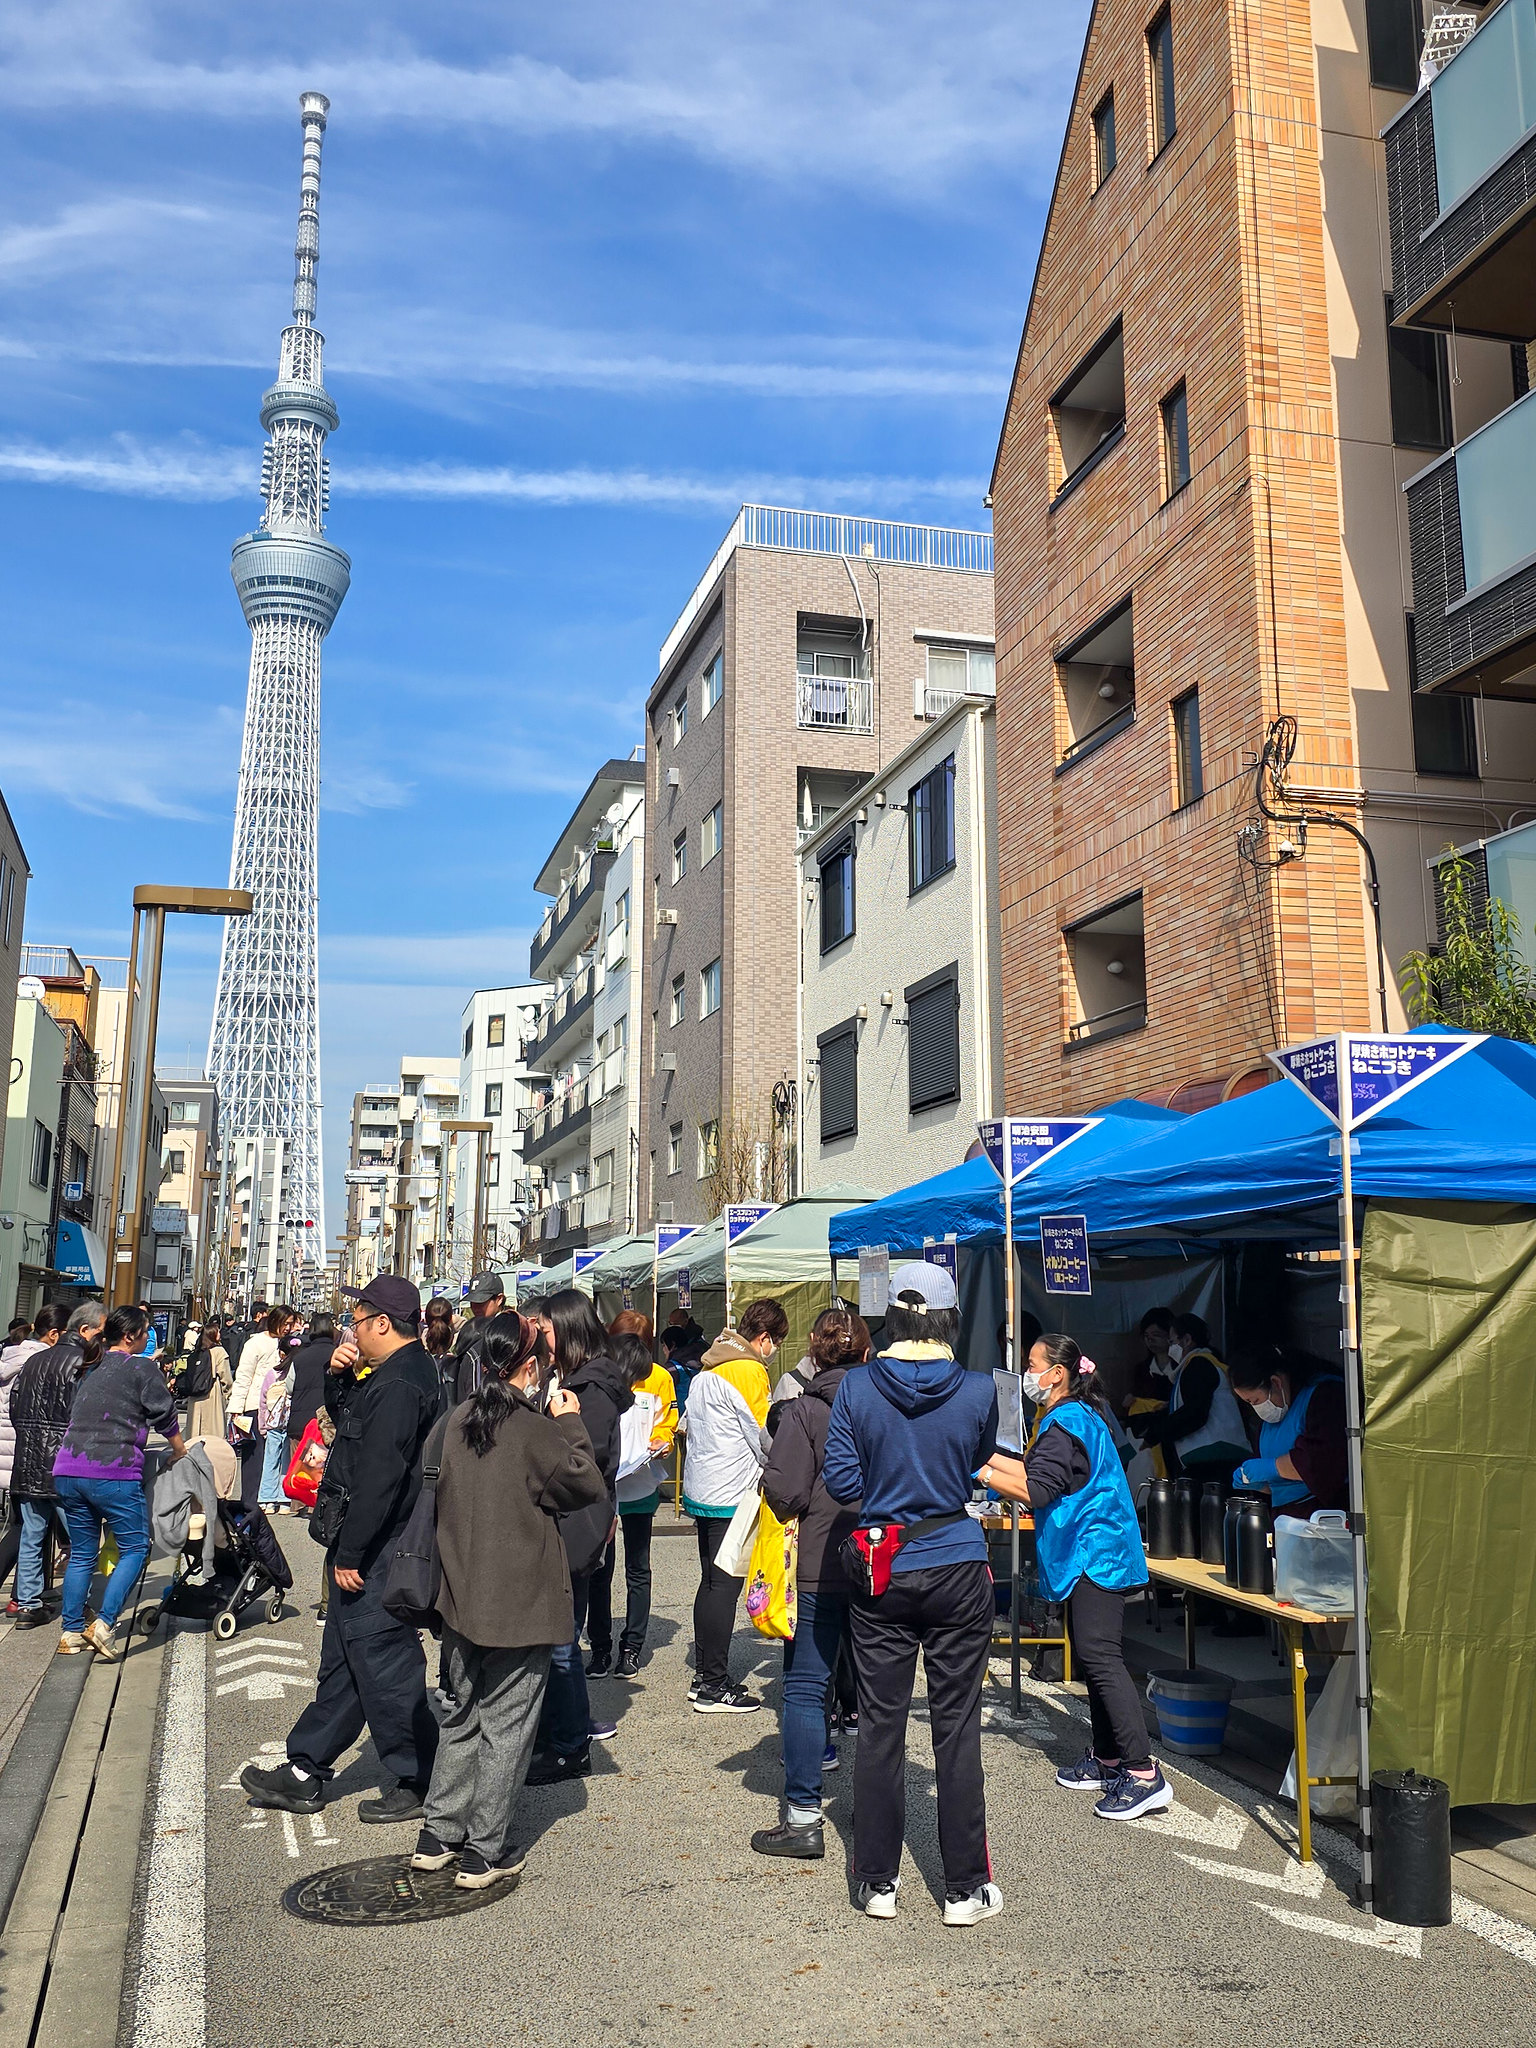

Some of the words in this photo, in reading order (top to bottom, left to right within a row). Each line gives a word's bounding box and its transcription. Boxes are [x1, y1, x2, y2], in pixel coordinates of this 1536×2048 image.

[1290, 1044, 1335, 1070] 厚焼きホットケーキ
[1351, 1043, 1437, 1061] 厚焼きホットケーキ
[1303, 1060, 1336, 1081] ねこづき
[1352, 1059, 1412, 1076] ねこづき
[1054, 1238, 1074, 1250] ねこづき
